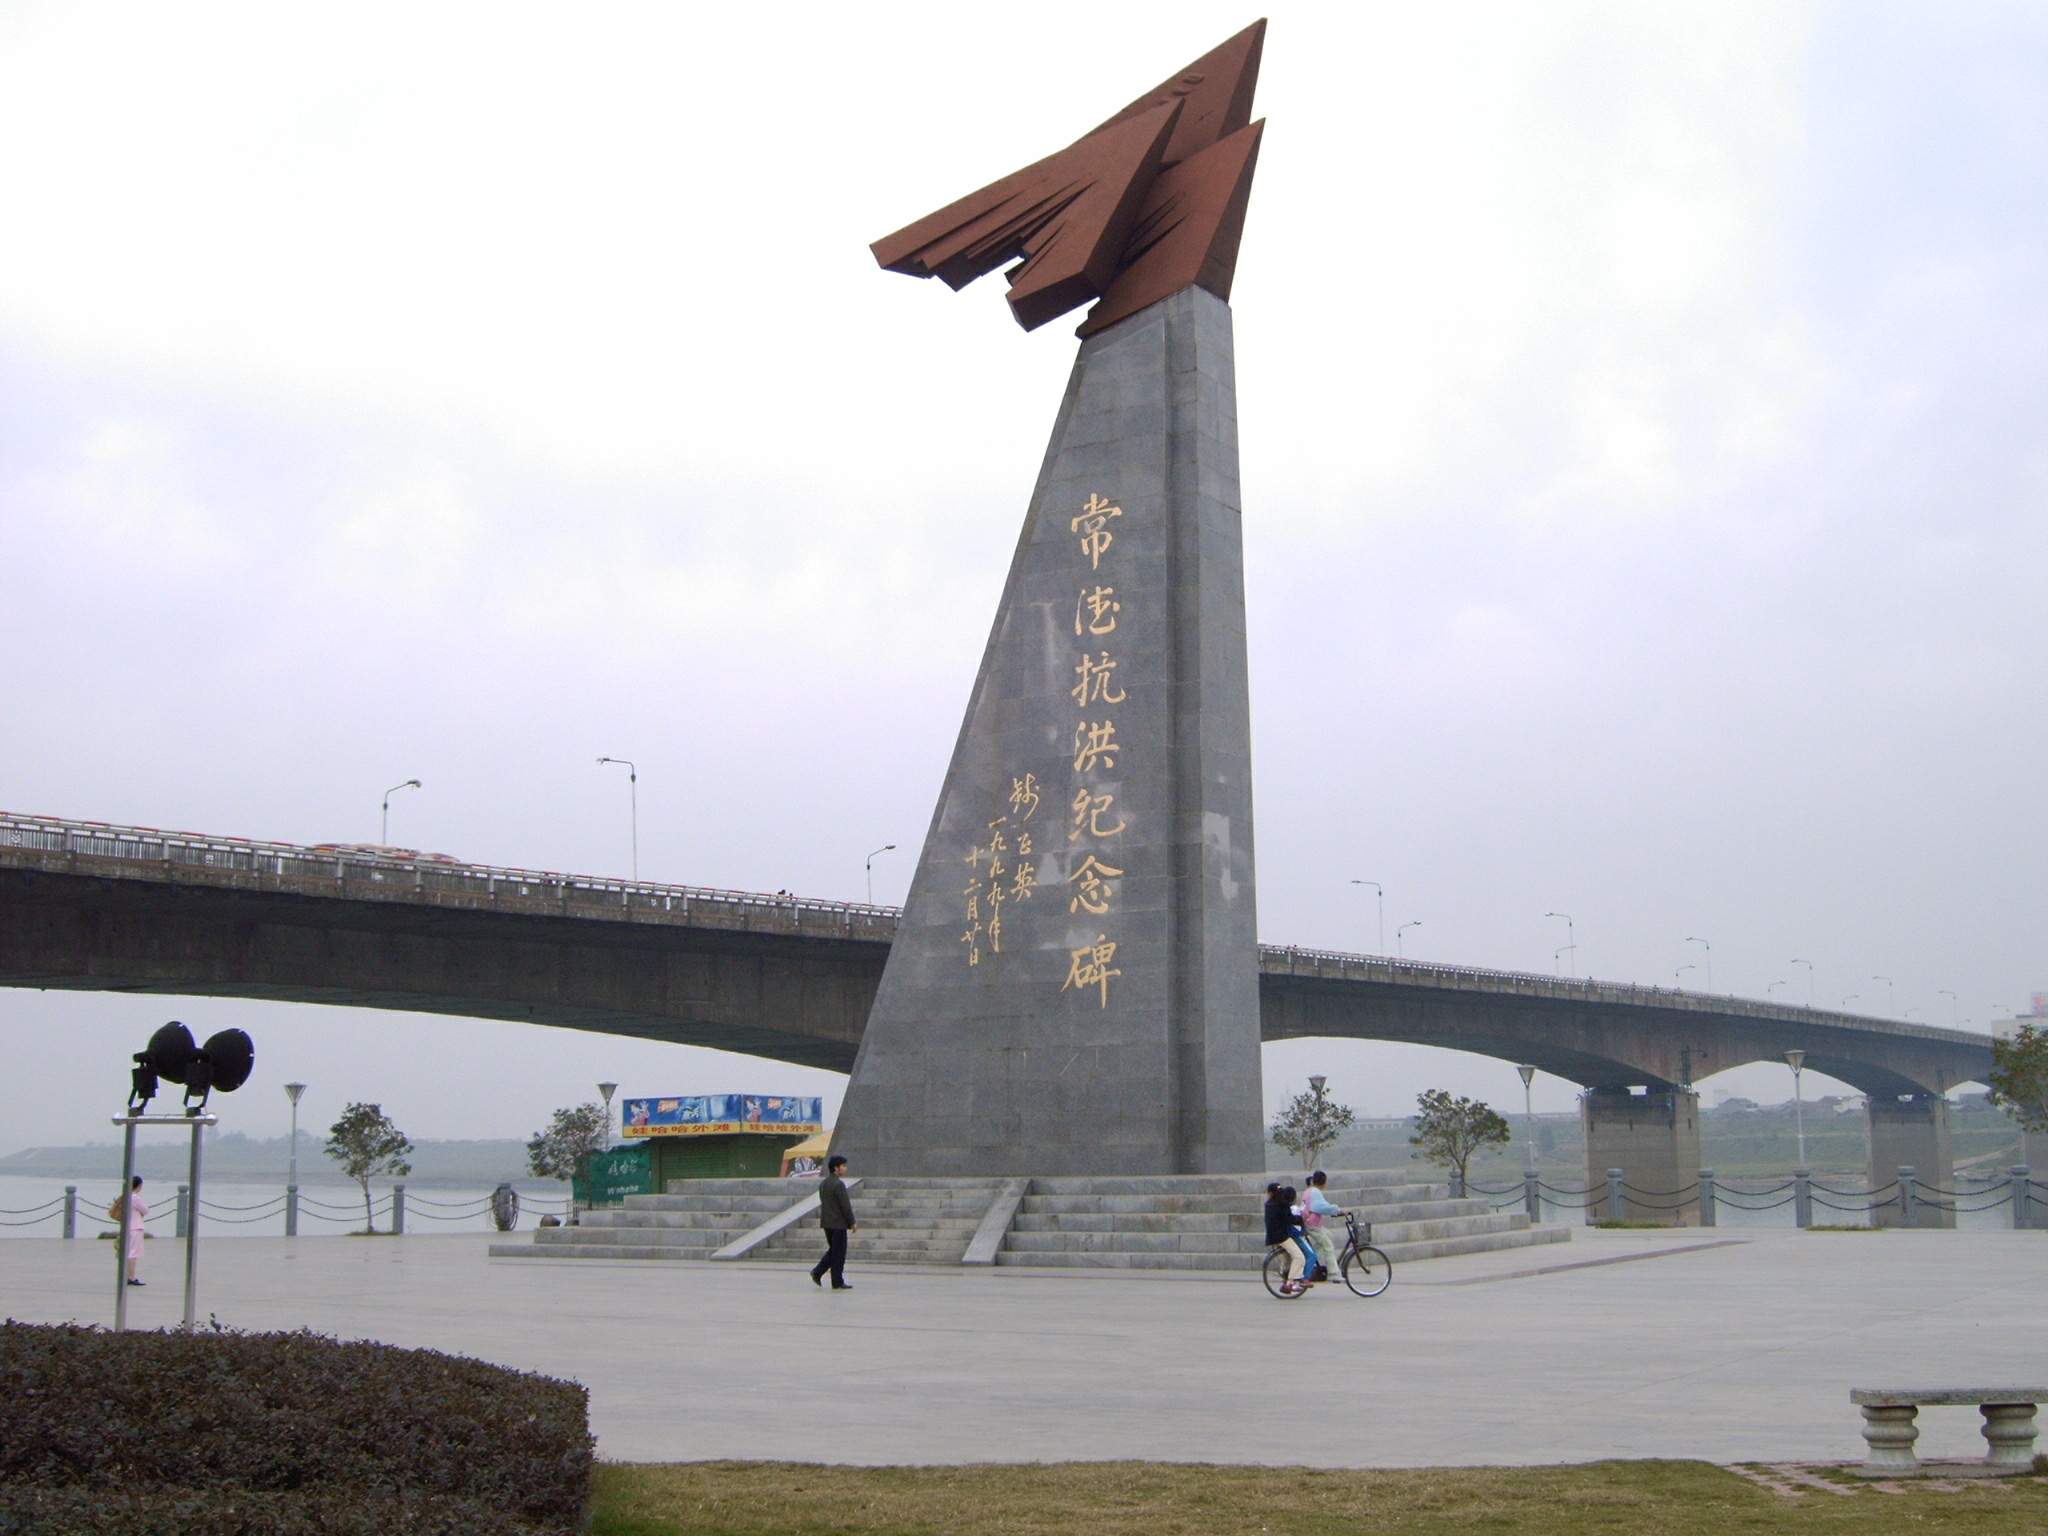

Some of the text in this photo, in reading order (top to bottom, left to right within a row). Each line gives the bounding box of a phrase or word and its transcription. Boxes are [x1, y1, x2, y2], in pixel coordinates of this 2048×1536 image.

[987, 816, 1007, 953] 一九九九年
[1061, 493, 1126, 1009] 常德抗洪纪念碑
